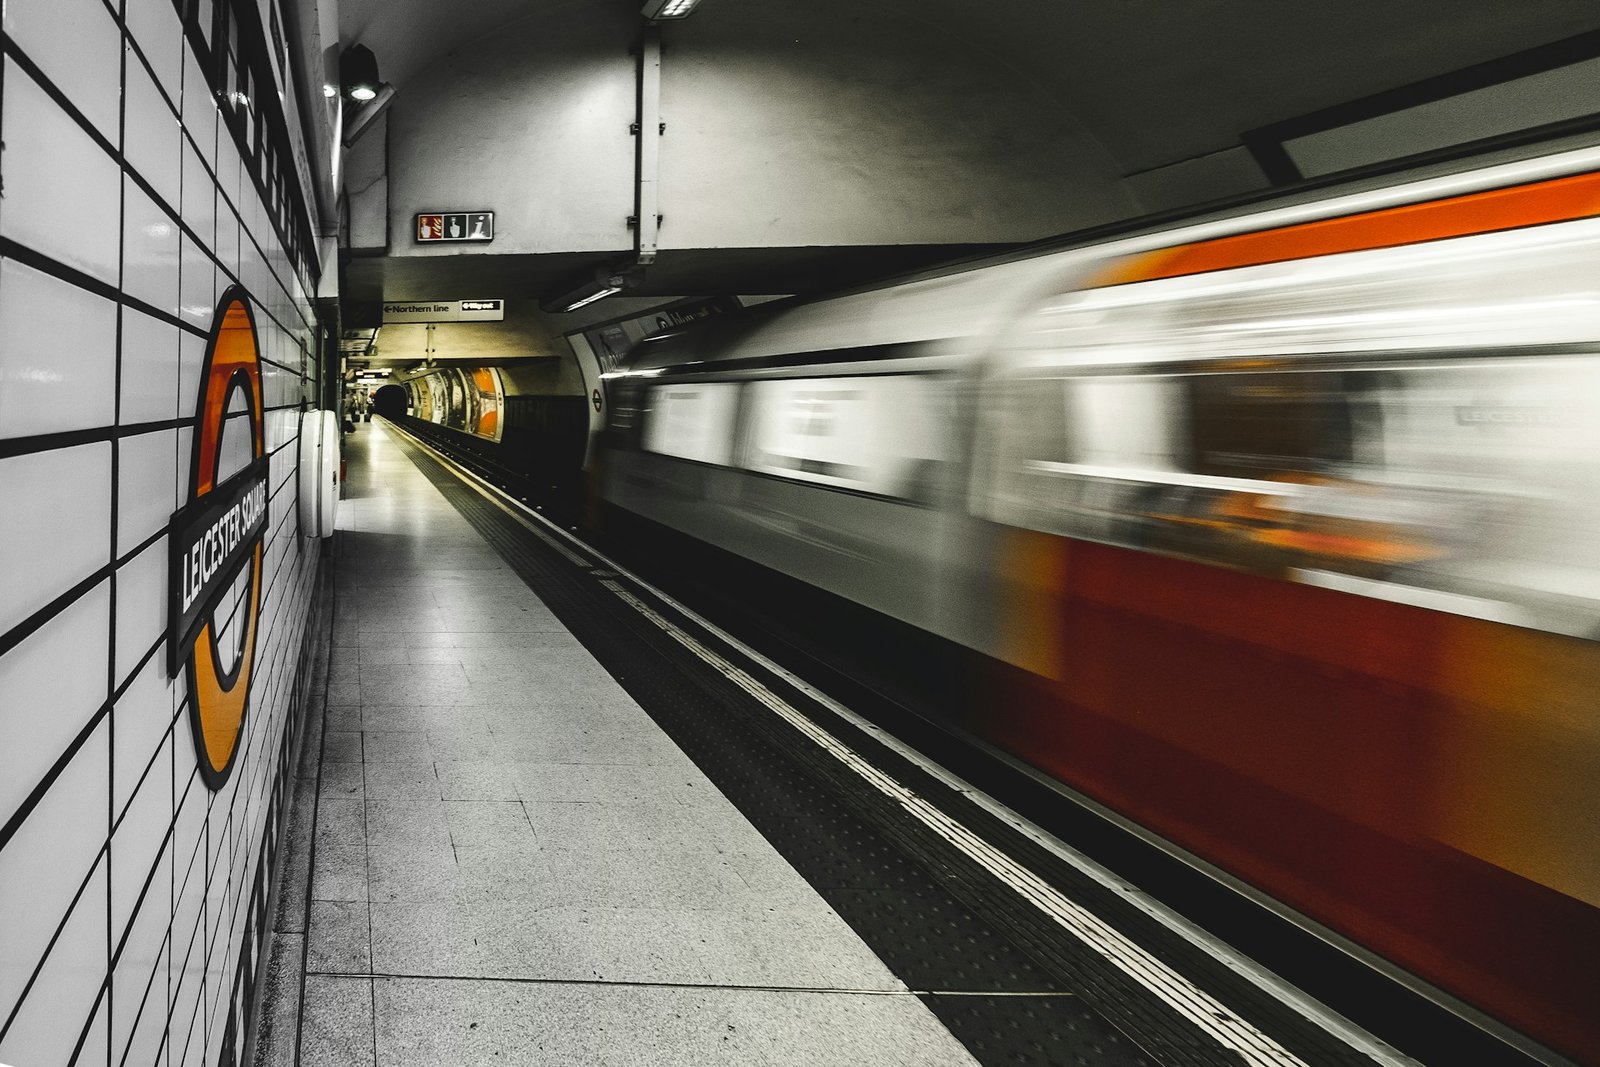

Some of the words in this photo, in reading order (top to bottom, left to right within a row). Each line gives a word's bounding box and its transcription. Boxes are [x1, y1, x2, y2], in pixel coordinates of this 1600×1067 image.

[392, 305, 431, 313] Northern
[433, 304, 449, 312] line
[182, 503, 241, 614] LEICESTER
[242, 478, 267, 536] SQUARE
